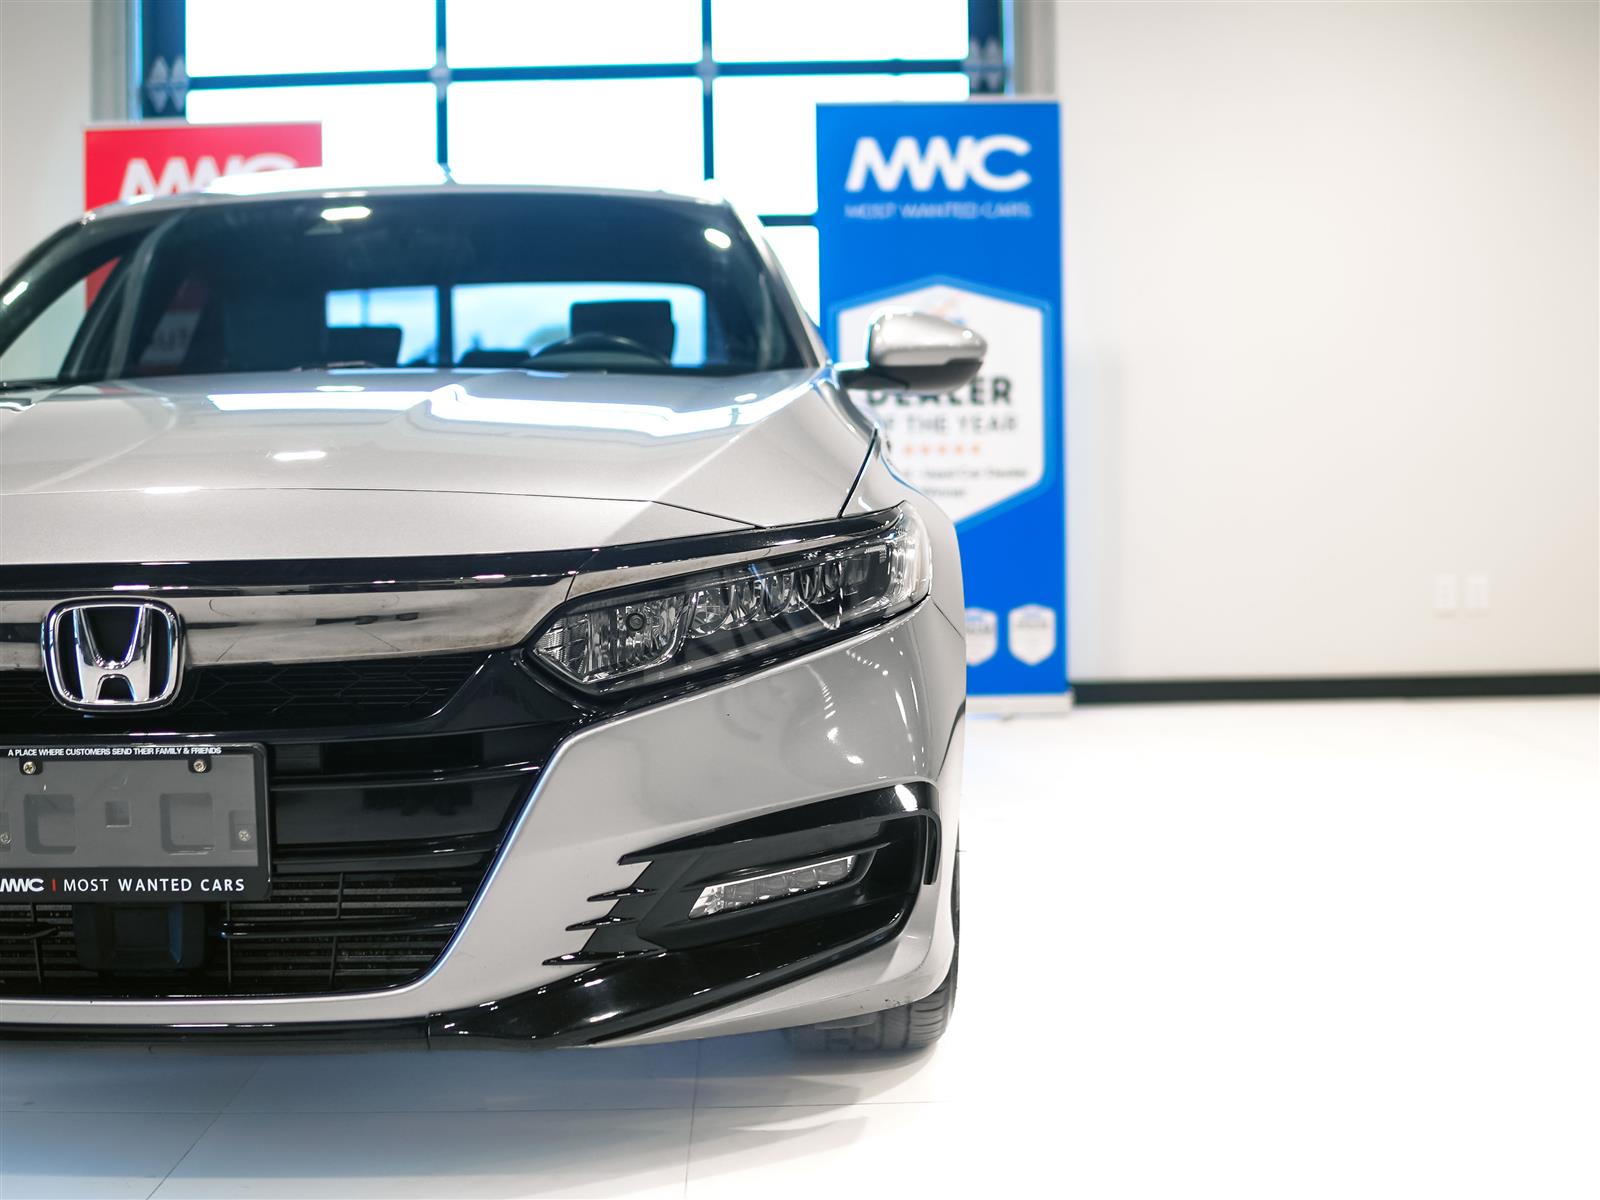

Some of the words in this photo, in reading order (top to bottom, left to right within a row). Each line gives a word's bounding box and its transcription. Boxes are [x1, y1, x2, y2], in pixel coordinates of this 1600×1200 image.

[845, 134, 1032, 192] MWC
[66, 748, 111, 756] CUSTOMERS
[155, 747, 182, 755] FAMILY
[183, 747, 190, 755] &
[191, 747, 222, 755] FRIENDS
[0, 878, 45, 893] MWC
[63, 878, 109, 892] MOST
[117, 878, 193, 892] WANTED
[200, 878, 245, 892] CARS
